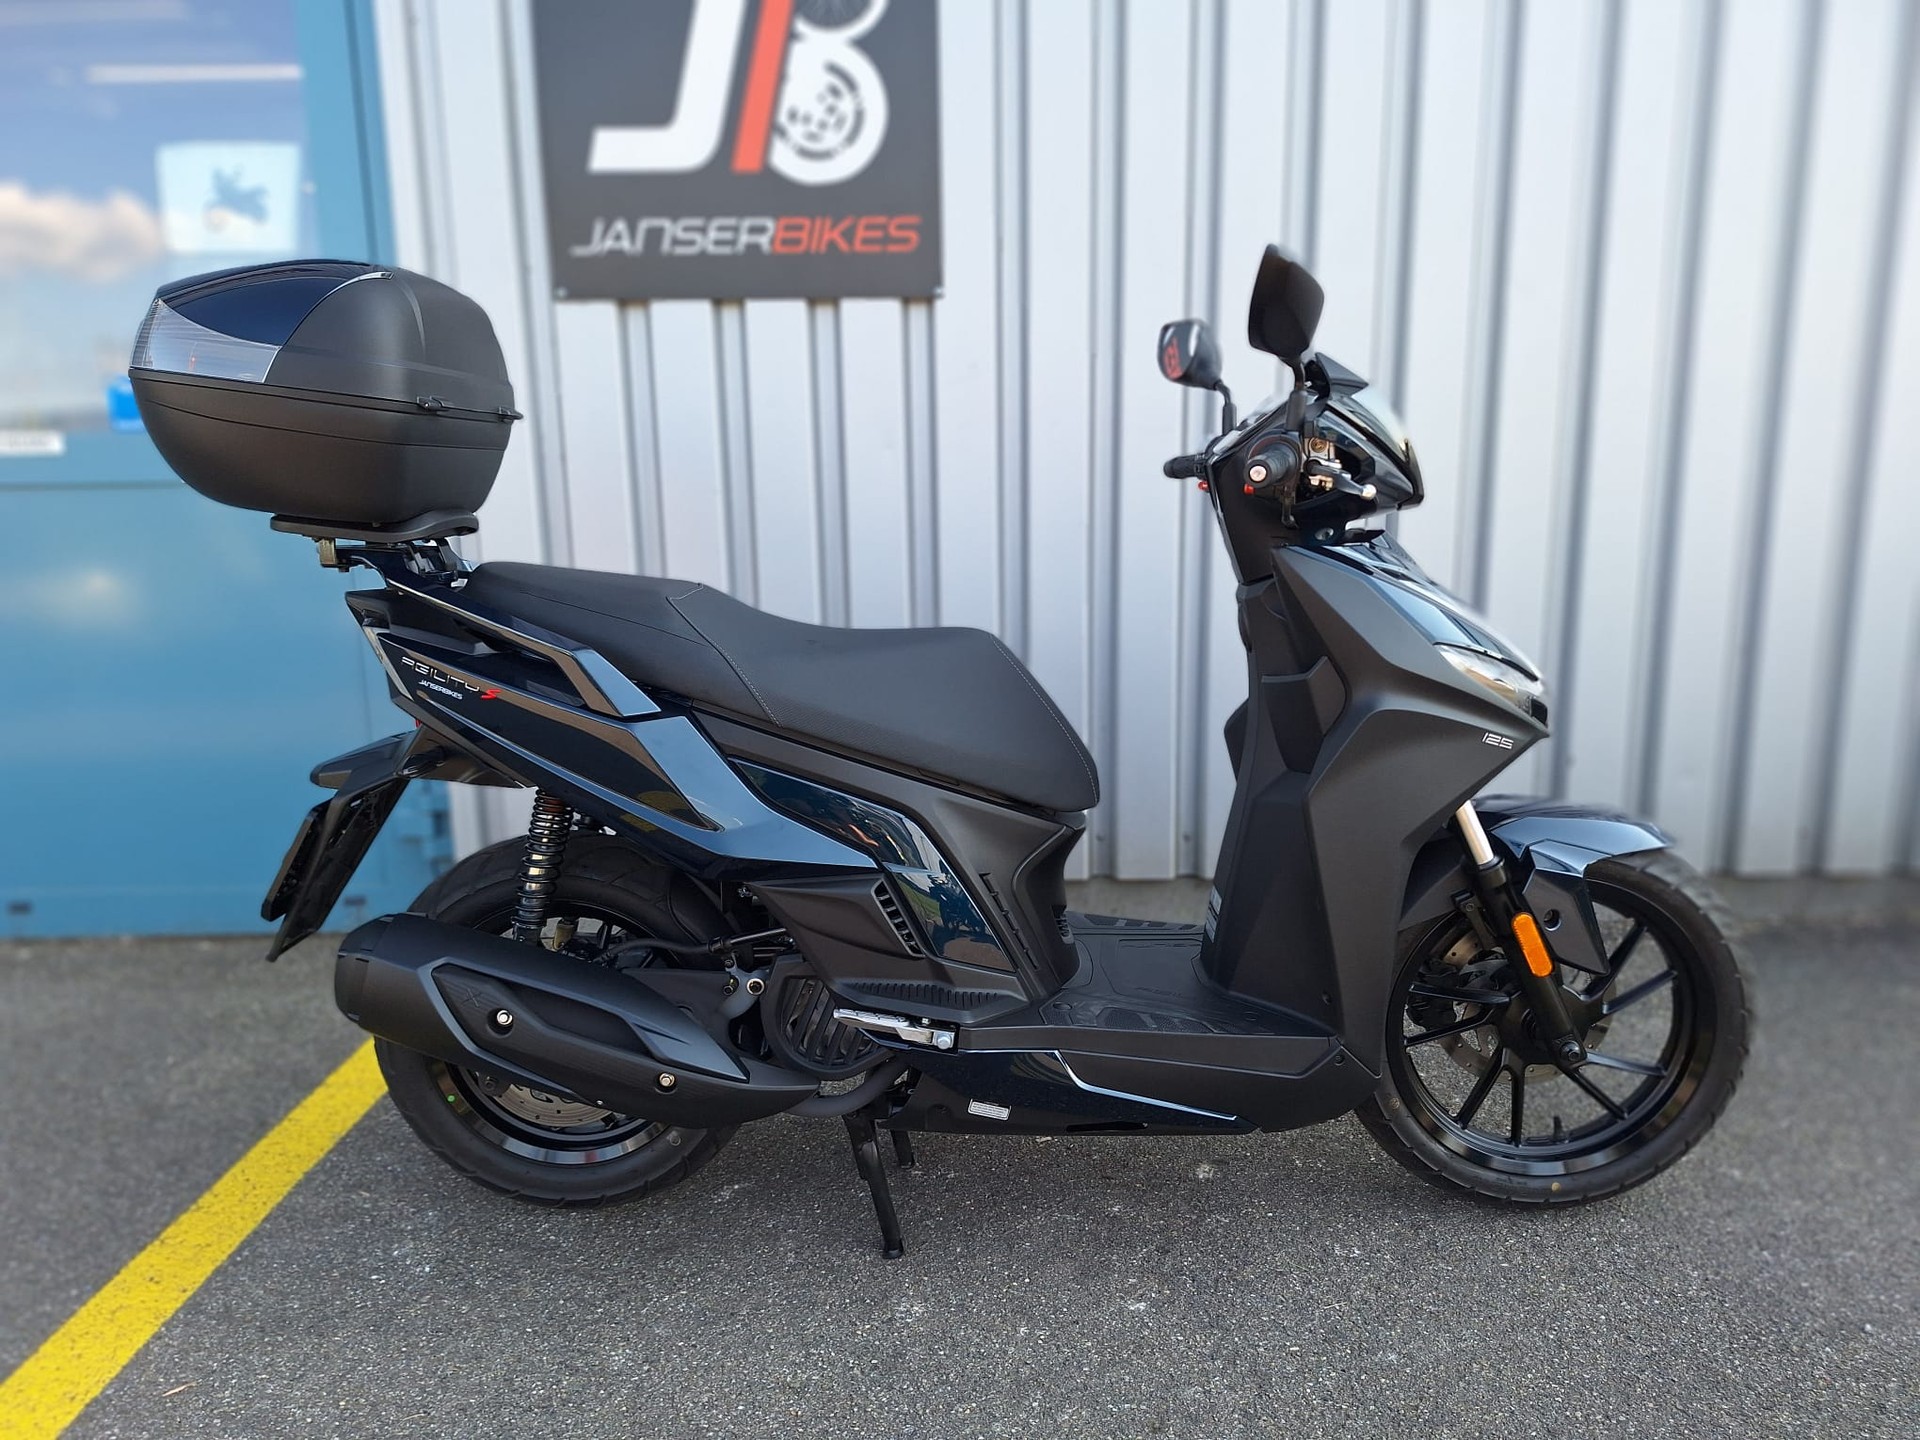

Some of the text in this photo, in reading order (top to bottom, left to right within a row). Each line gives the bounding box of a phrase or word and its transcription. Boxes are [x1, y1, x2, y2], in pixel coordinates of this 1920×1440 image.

[570, 215, 921, 258] JANSERBIKES
[480, 687, 503, 700] S
[1482, 732, 1514, 750] 125
